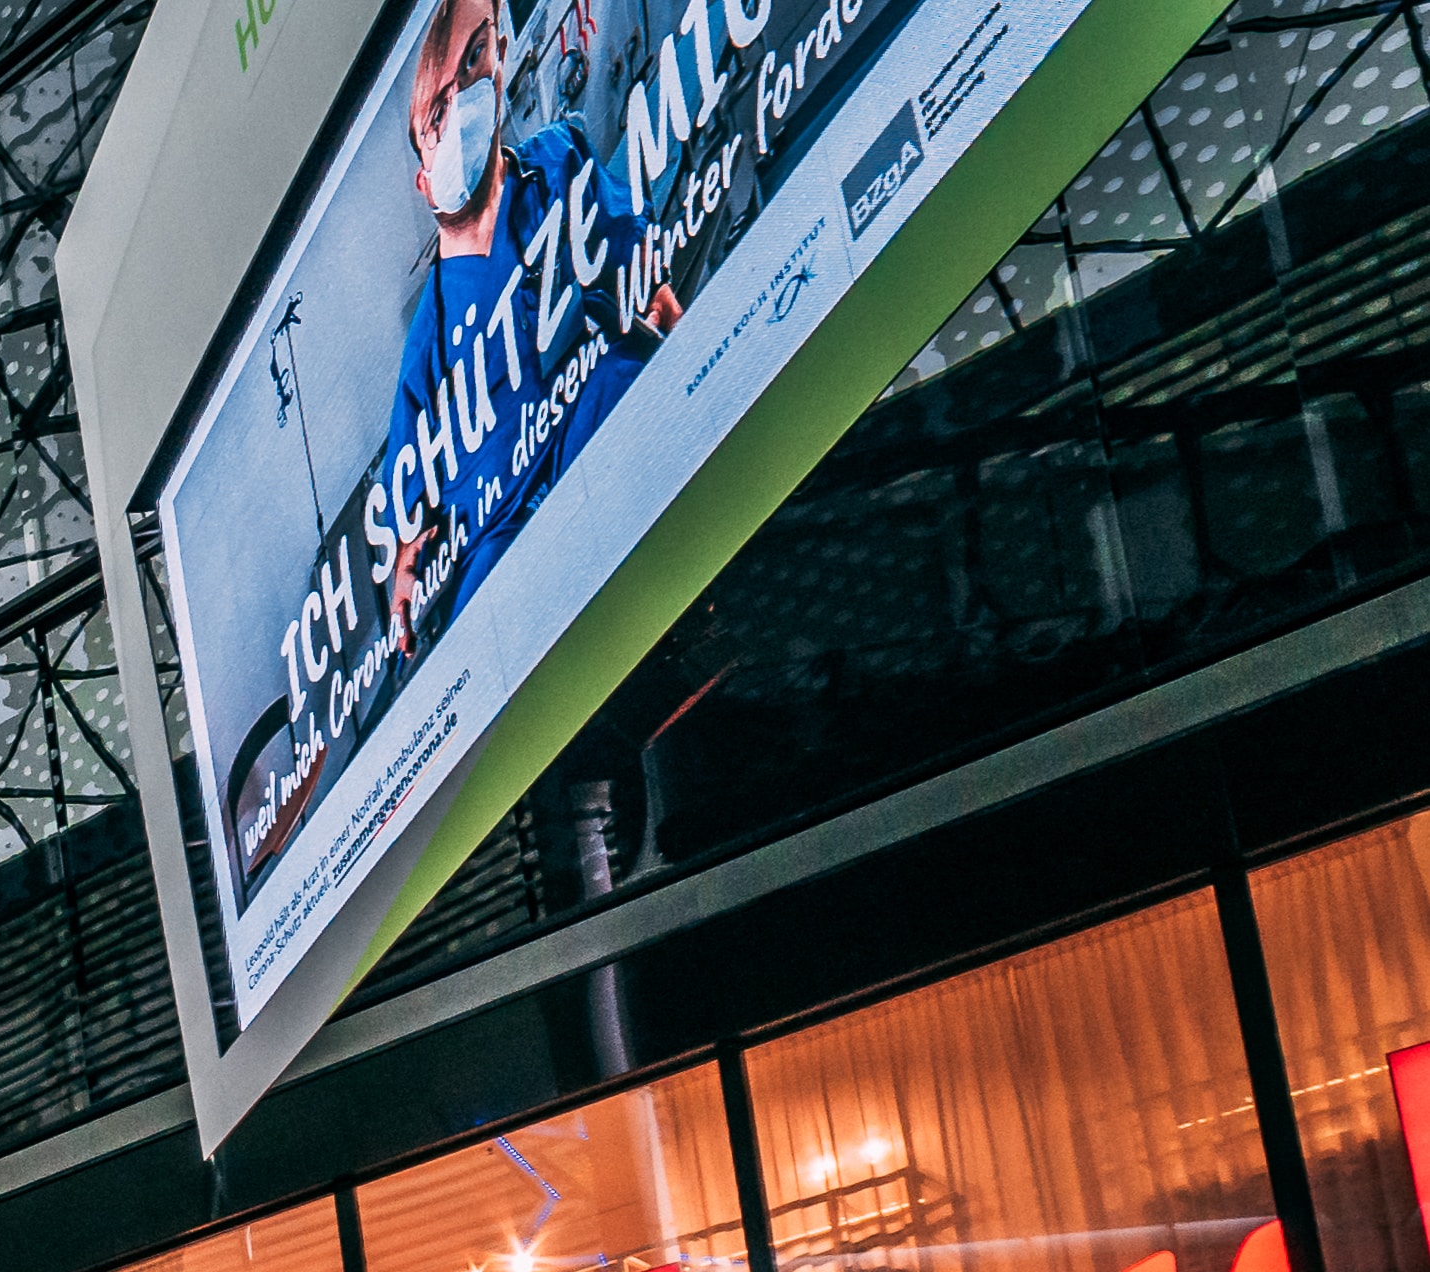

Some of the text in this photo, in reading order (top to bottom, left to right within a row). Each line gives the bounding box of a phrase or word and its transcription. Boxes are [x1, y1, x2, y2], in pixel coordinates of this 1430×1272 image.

[686, 216, 826, 397] ROBERT KOCH INSTITUT
[851, 141, 921, 231] BZgA
[244, 771, 276, 857] weil
[280, 711, 325, 806] mich
[329, 613, 405, 739] Corona
[410, 504, 468, 620] auch
[477, 475, 502, 527] in
[512, 333, 608, 476] diesem
[617, 134, 742, 334] Winter
[281, 535, 358, 723] ICH
[364, 158, 608, 585] SCHÜTZE
